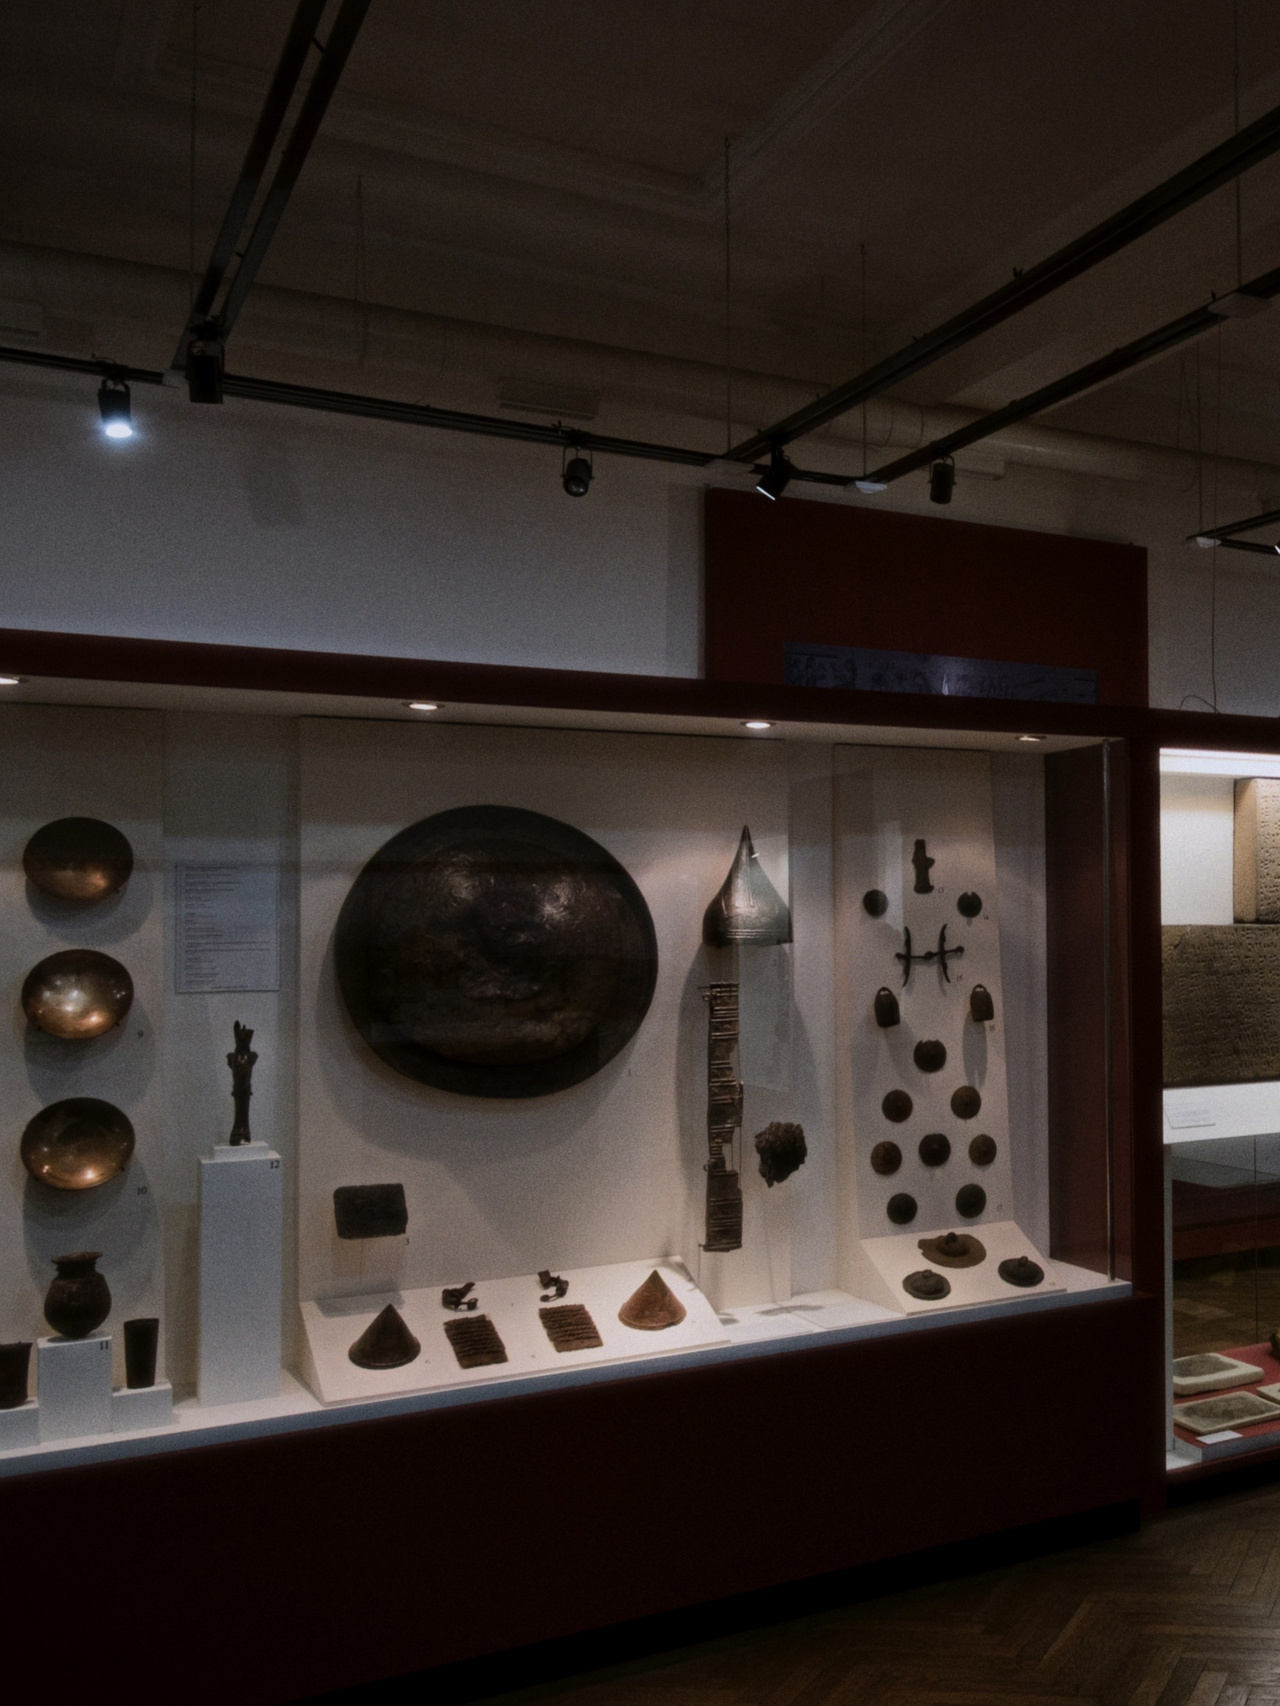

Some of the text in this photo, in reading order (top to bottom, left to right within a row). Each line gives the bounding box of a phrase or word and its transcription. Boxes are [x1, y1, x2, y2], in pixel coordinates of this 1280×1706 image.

[269, 1159, 280, 1169] 12
[137, 1186, 148, 1195] 10
[100, 1341, 109, 1350] 11
